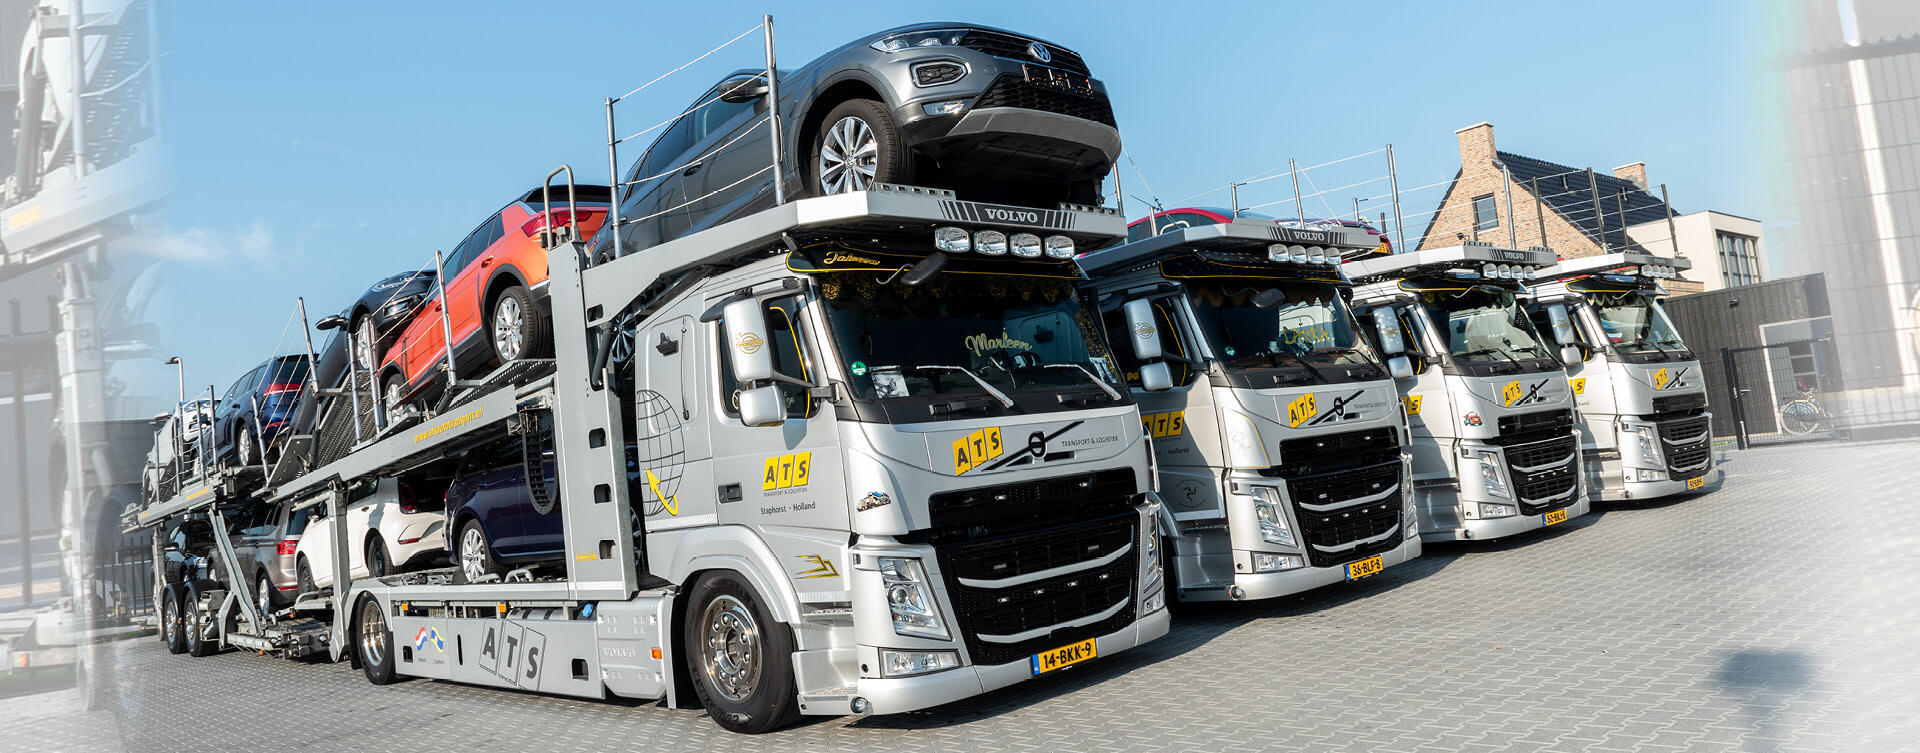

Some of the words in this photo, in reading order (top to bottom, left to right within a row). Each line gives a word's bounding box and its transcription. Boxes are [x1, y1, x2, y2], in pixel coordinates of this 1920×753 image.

[985, 208, 1038, 223] VOLVO
[1294, 231, 1325, 241] VOLVO
[1503, 251, 1524, 260] VOLVO
[965, 331, 1032, 357] Marleen
[1505, 383, 1520, 402] ATS
[1291, 397, 1315, 423] ATS
[957, 431, 999, 467] ATS
[1061, 438, 1090, 447] TRANSPORT
[765, 460, 807, 483] ATS
[760, 505, 787, 515] Staphorst
[793, 501, 816, 511] Holland
[483, 627, 539, 679] ATS
[1044, 642, 1091, 669] 14-BKK-9
